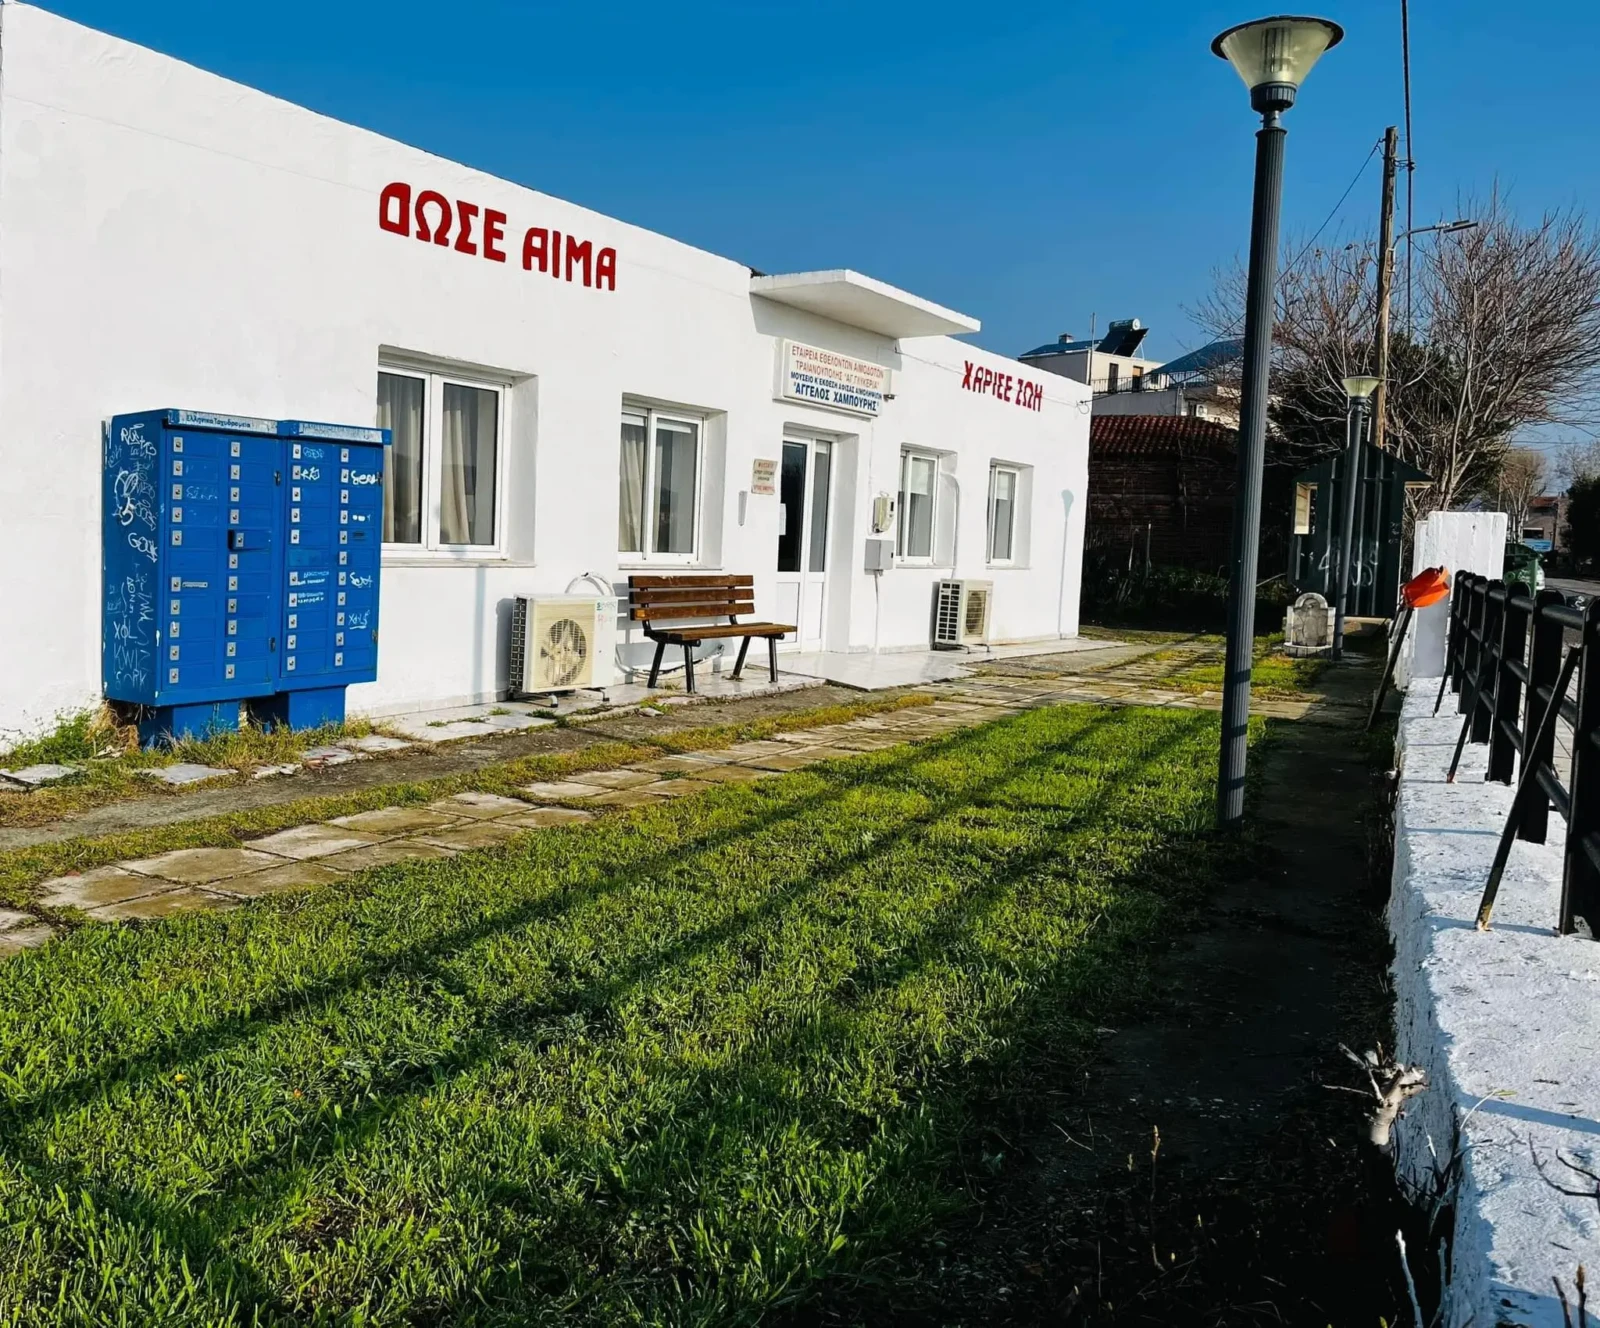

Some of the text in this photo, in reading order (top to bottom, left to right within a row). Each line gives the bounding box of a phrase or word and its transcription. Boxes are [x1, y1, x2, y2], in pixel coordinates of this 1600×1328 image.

[379, 181, 617, 291] ΔΩΣΕ ΑΙΜΑ
[792, 345, 818, 362] ΕΤΑΙΡΕΙΑ
[819, 353, 853, 370] ΕΘΕΛΟΝΤΩΝ
[790, 372, 814, 383] ΜΟΥΣΕΙΟ
[961, 360, 1043, 412] ΧΑΡΙΣΕ ΖΩΗ
